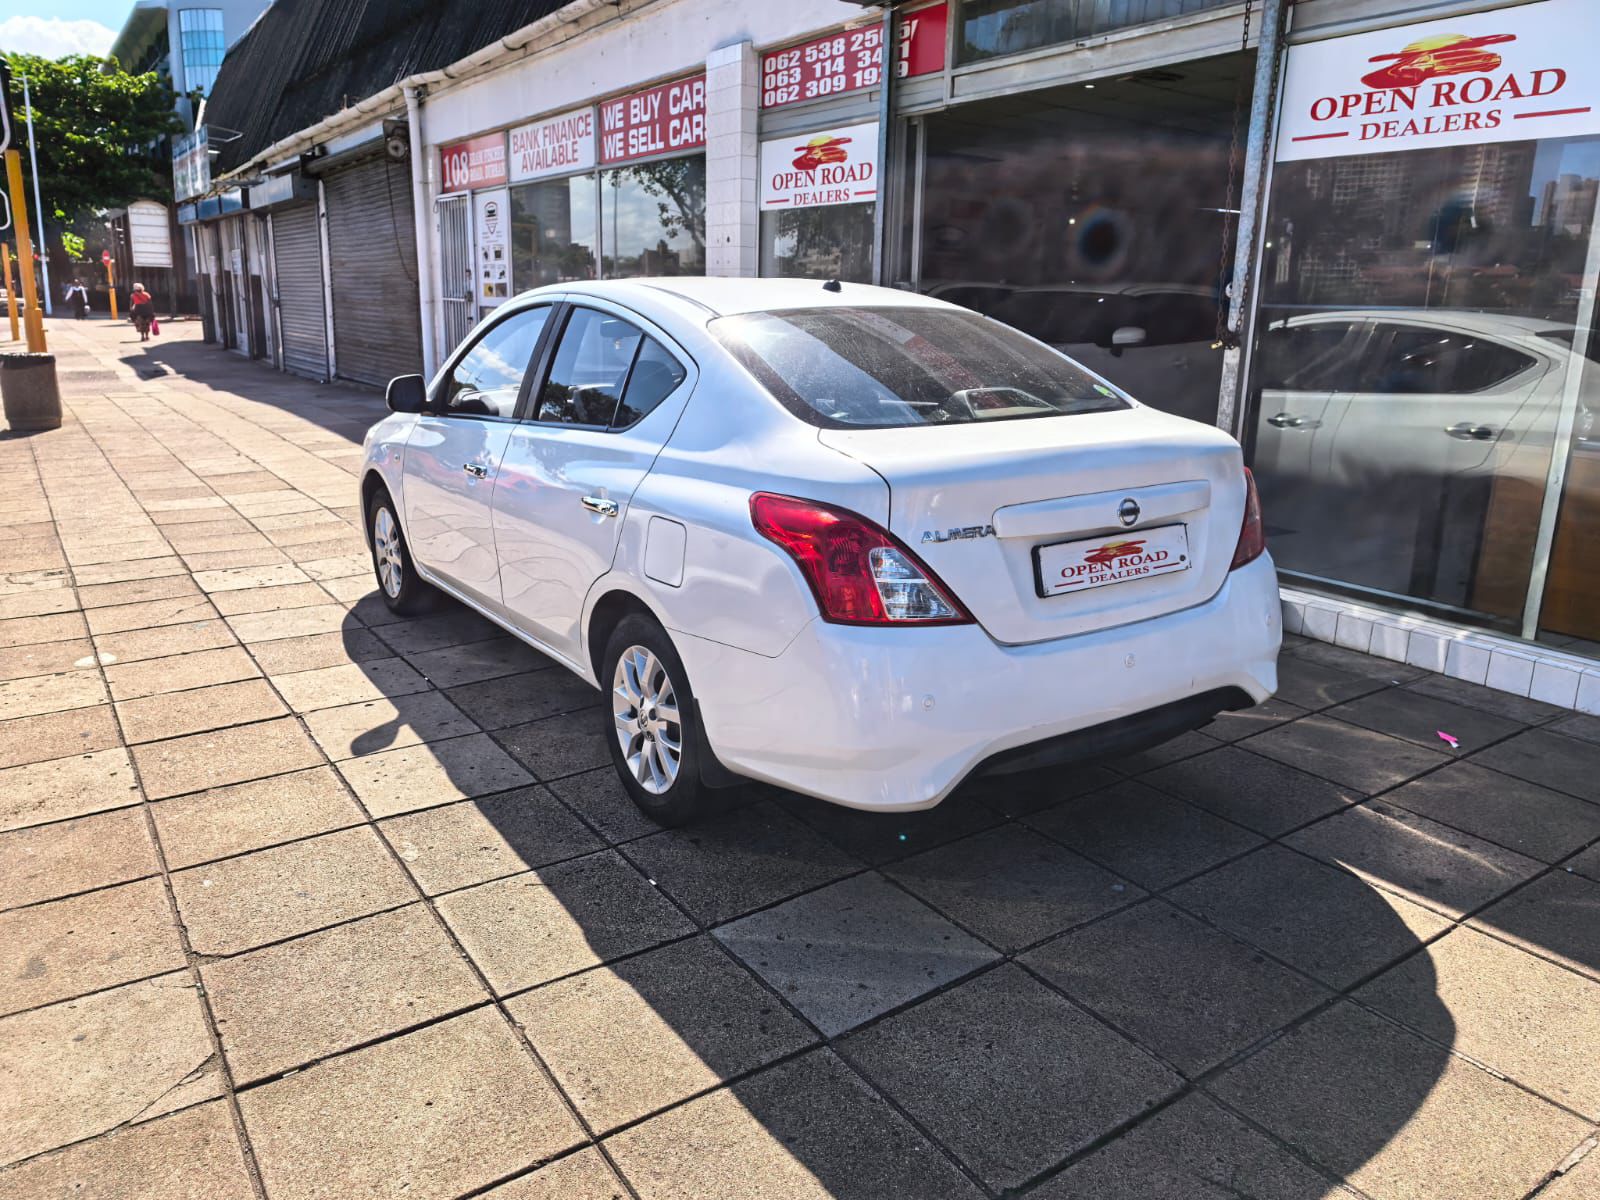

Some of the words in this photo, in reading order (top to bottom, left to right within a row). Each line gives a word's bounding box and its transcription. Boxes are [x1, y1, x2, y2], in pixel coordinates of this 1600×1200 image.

[765, 50, 801, 73] 062
[805, 37, 846, 63] 538
[764, 67, 802, 90] 063
[812, 56, 846, 78] 114
[603, 102, 624, 131] WE
[630, 92, 662, 125] BUY
[669, 81, 706, 116] CAR
[764, 85, 800, 107] 062
[805, 74, 847, 98] 309
[1309, 86, 1421, 121] OPEN
[1429, 67, 1567, 108] ROAD
[512, 129, 541, 155] BANK
[543, 113, 592, 148] FINANCE
[603, 132, 625, 160] WE
[628, 123, 665, 155] SELL
[669, 114, 706, 147] CAR
[1358, 108, 1502, 141] DEALERS
[443, 151, 469, 188] 108
[521, 141, 579, 173] AVAILABLE
[772, 169, 816, 191] OPEN
[821, 161, 873, 184] ROAD
[794, 188, 850, 206] DEALERS
[921, 524, 995, 544] ALMERA
[1061, 561, 1113, 579] OPEN
[1118, 550, 1169, 569] ROAD
[1088, 565, 1150, 584] DEALERS
